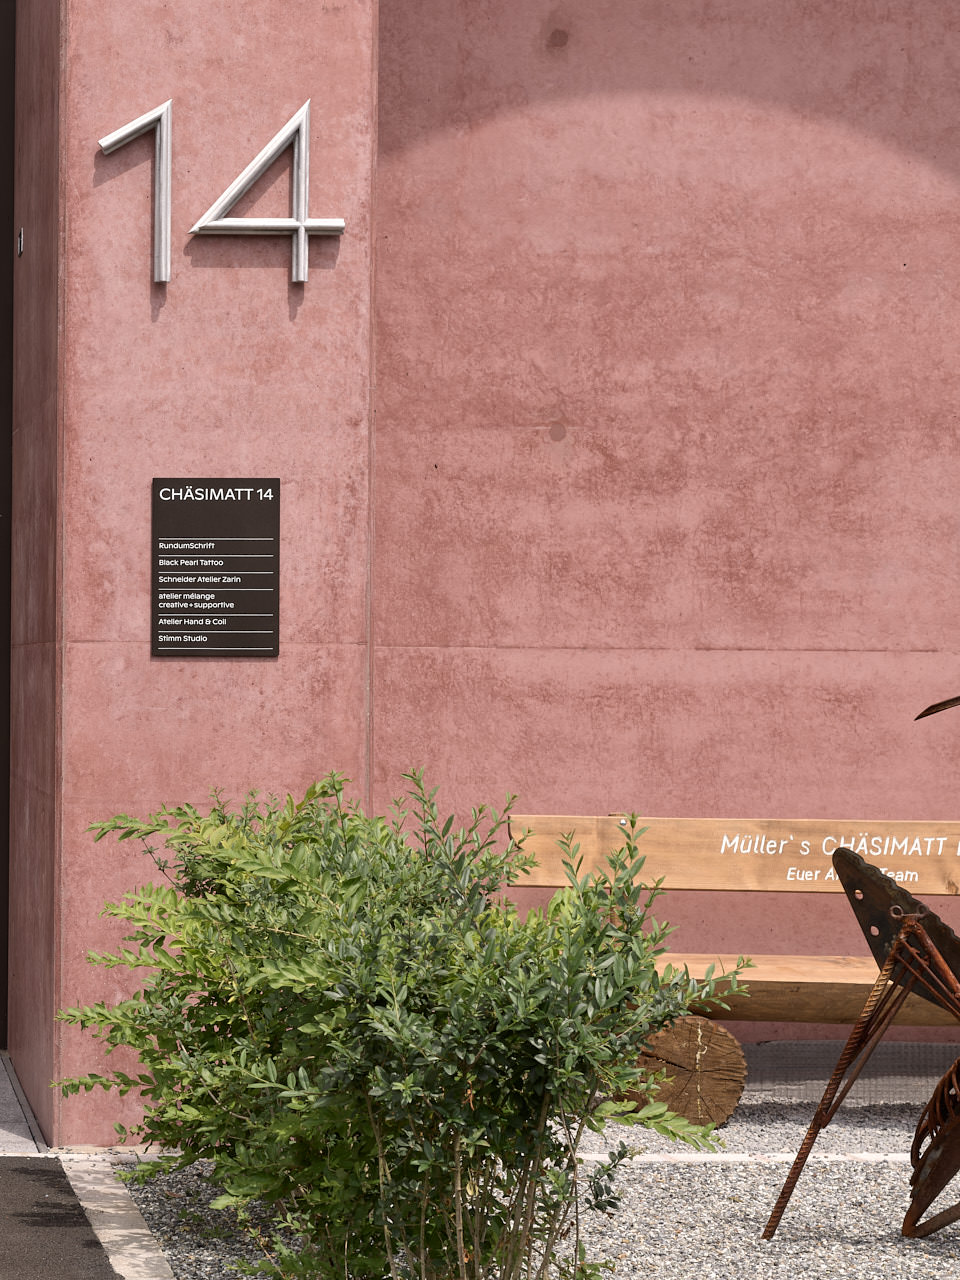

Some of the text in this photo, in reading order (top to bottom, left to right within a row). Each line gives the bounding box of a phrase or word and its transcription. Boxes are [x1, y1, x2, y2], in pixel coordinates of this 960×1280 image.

[98, 99, 345, 282] 14
[159, 485, 274, 501] CHÄSIMATT 14
[158, 542, 216, 550] RundumSchrift
[158, 559, 224, 567] Black Pearl Tattoo
[158, 575, 196, 583] Schneider
[197, 575, 221, 583] Atelier
[158, 592, 216, 601] atelier mélange
[158, 618, 182, 626] Atelier
[183, 618, 204, 626] Hand
[204, 618, 212, 626] &
[158, 634, 208, 642] Stimm Studio
[822, 832, 948, 857] CHÄSIMATT
[786, 867, 821, 881] Euer
